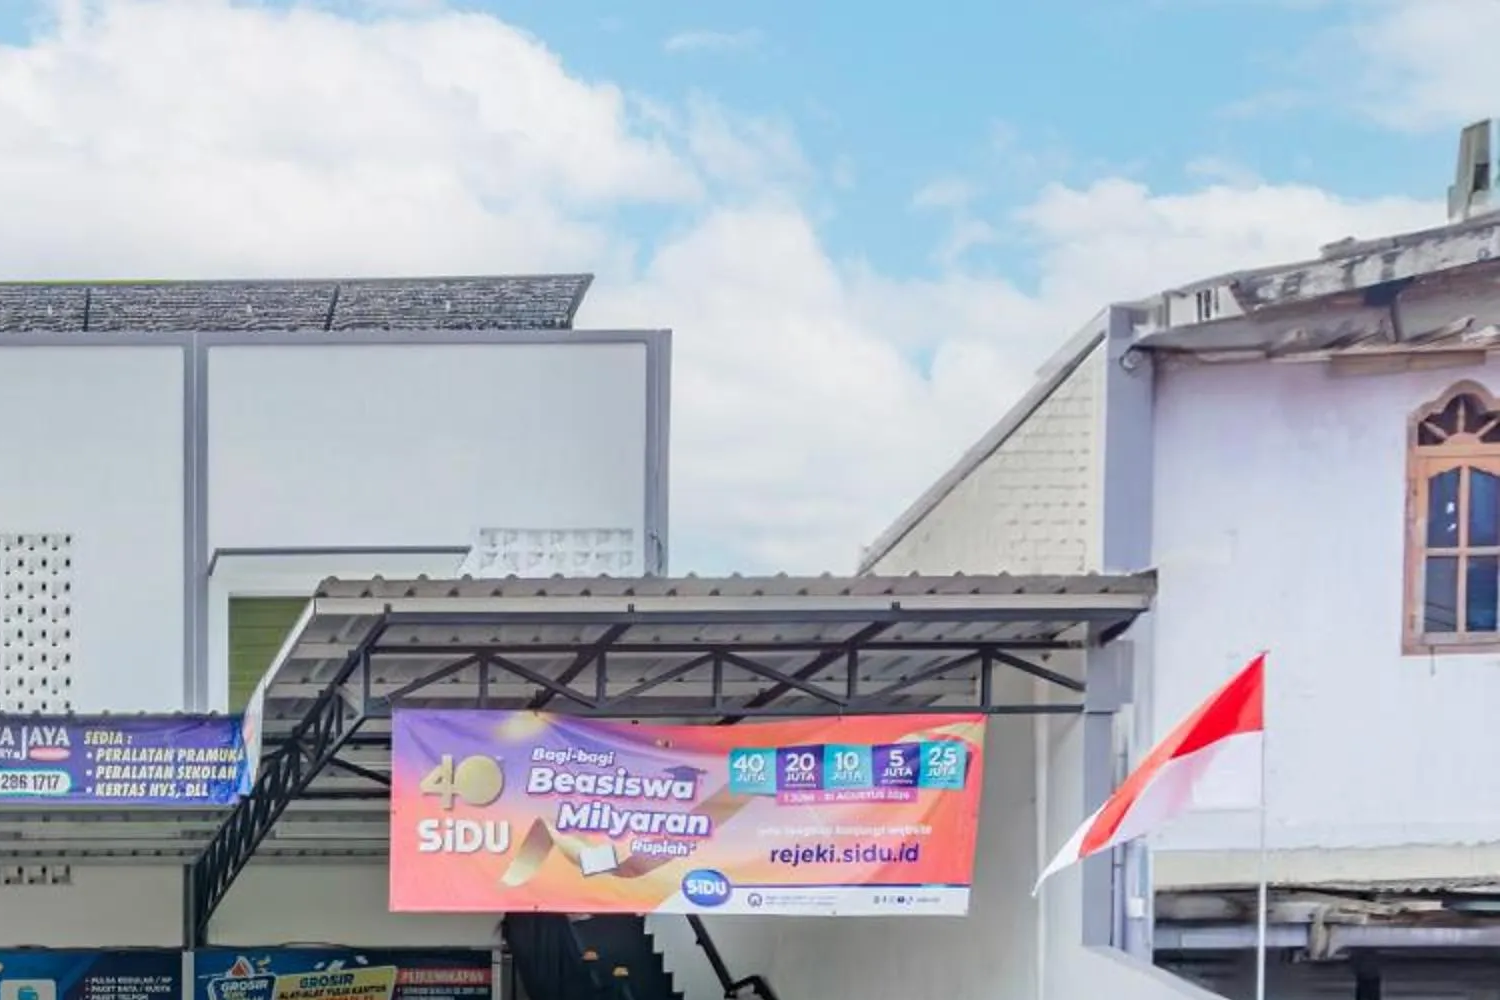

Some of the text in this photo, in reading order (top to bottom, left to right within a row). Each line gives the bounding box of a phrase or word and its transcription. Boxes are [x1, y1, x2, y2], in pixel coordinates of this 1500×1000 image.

[20, 725, 71, 760] JAYA
[84, 731, 124, 745] SEDIA
[96, 748, 244, 762] PERALATAN PRAMUKA
[531, 748, 615, 766] Bagi-bagi
[733, 753, 765, 773] 40
[785, 753, 815, 773] 20
[834, 751, 859, 771] 10
[889, 749, 905, 767] 5
[96, 766, 238, 780] PERALATAN SEKOLAH
[786, 771, 815, 782] JUTA
[883, 767, 913, 777] JUTA
[32, 773, 61, 790] 1717
[96, 783, 146, 797] KERTAS
[419, 754, 505, 811] 40
[527, 767, 695, 800] Beasiswa
[558, 803, 711, 837] Milyaran
[770, 843, 920, 867] rejeki.sidu.id
[220, 979, 269, 992] GROSIR
[300, 973, 355, 988] GROSIR
